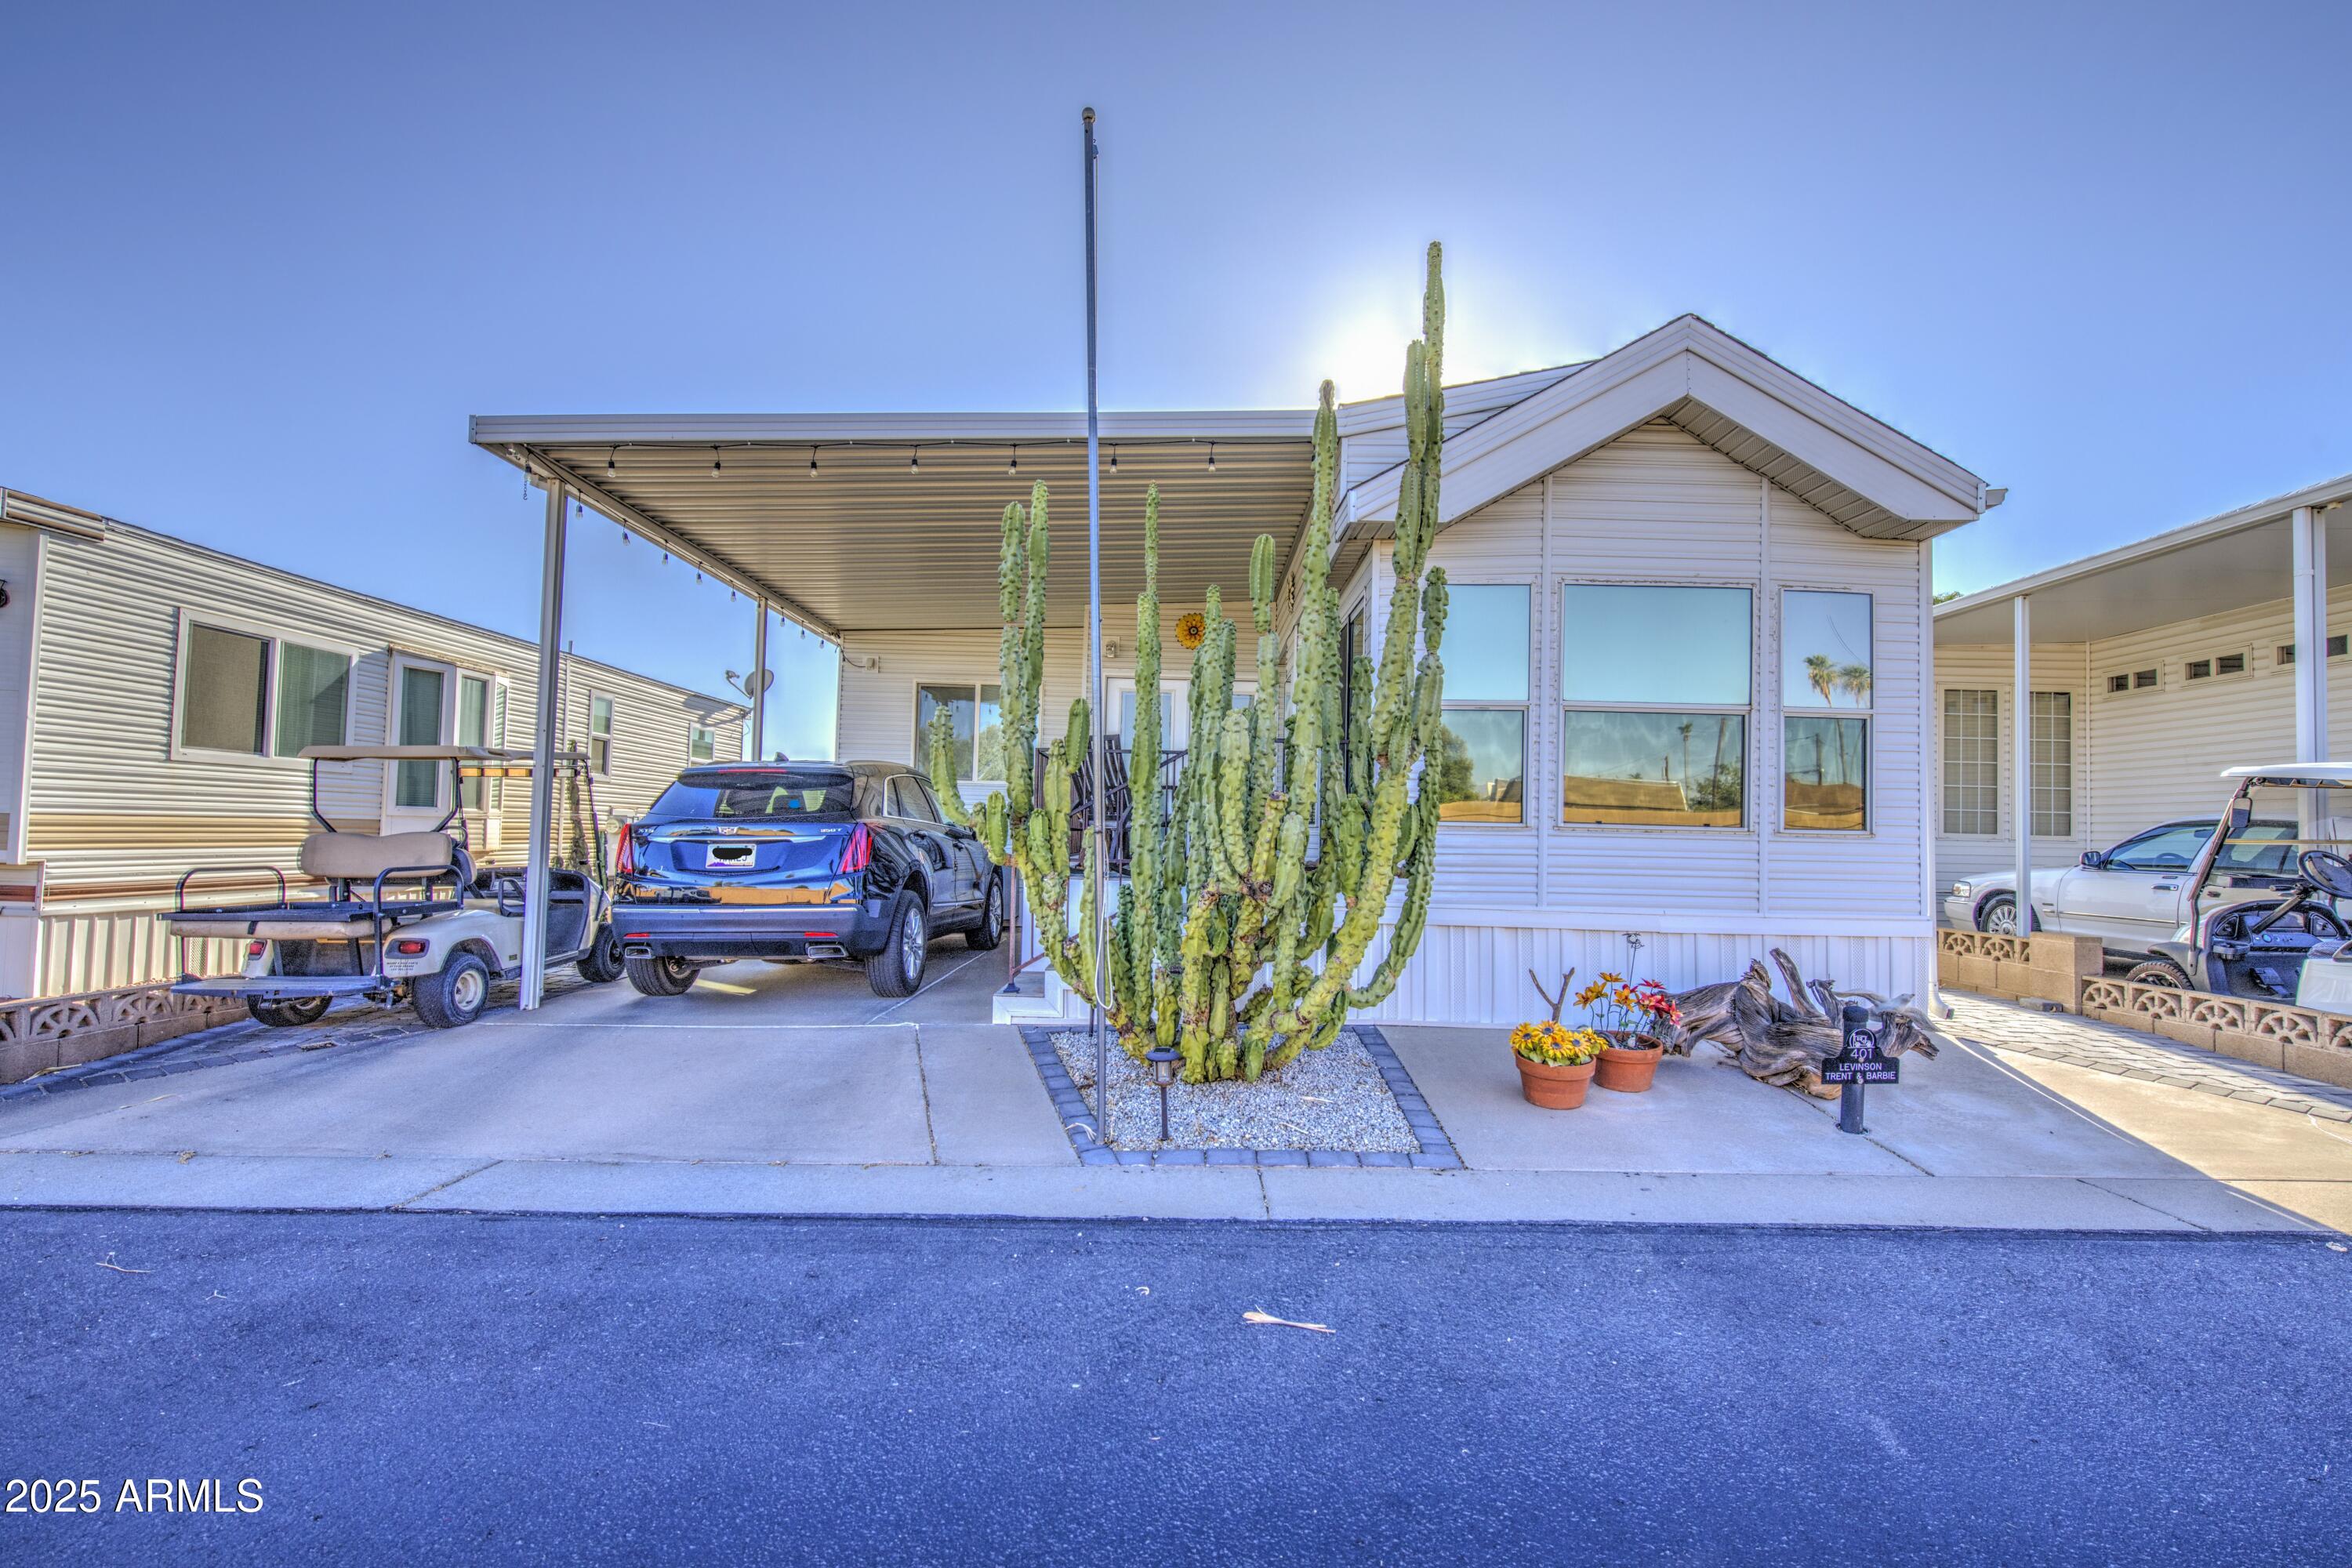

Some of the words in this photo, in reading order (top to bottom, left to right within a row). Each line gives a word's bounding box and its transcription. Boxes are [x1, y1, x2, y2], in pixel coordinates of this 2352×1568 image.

[1851, 1048, 1873, 1059] 401
[1839, 1062, 1882, 1071] LEVINSON
[1825, 1072, 1853, 1080] TRENT
[1856, 1072, 1863, 1080] &
[1866, 1071, 1896, 1080] BARBIE
